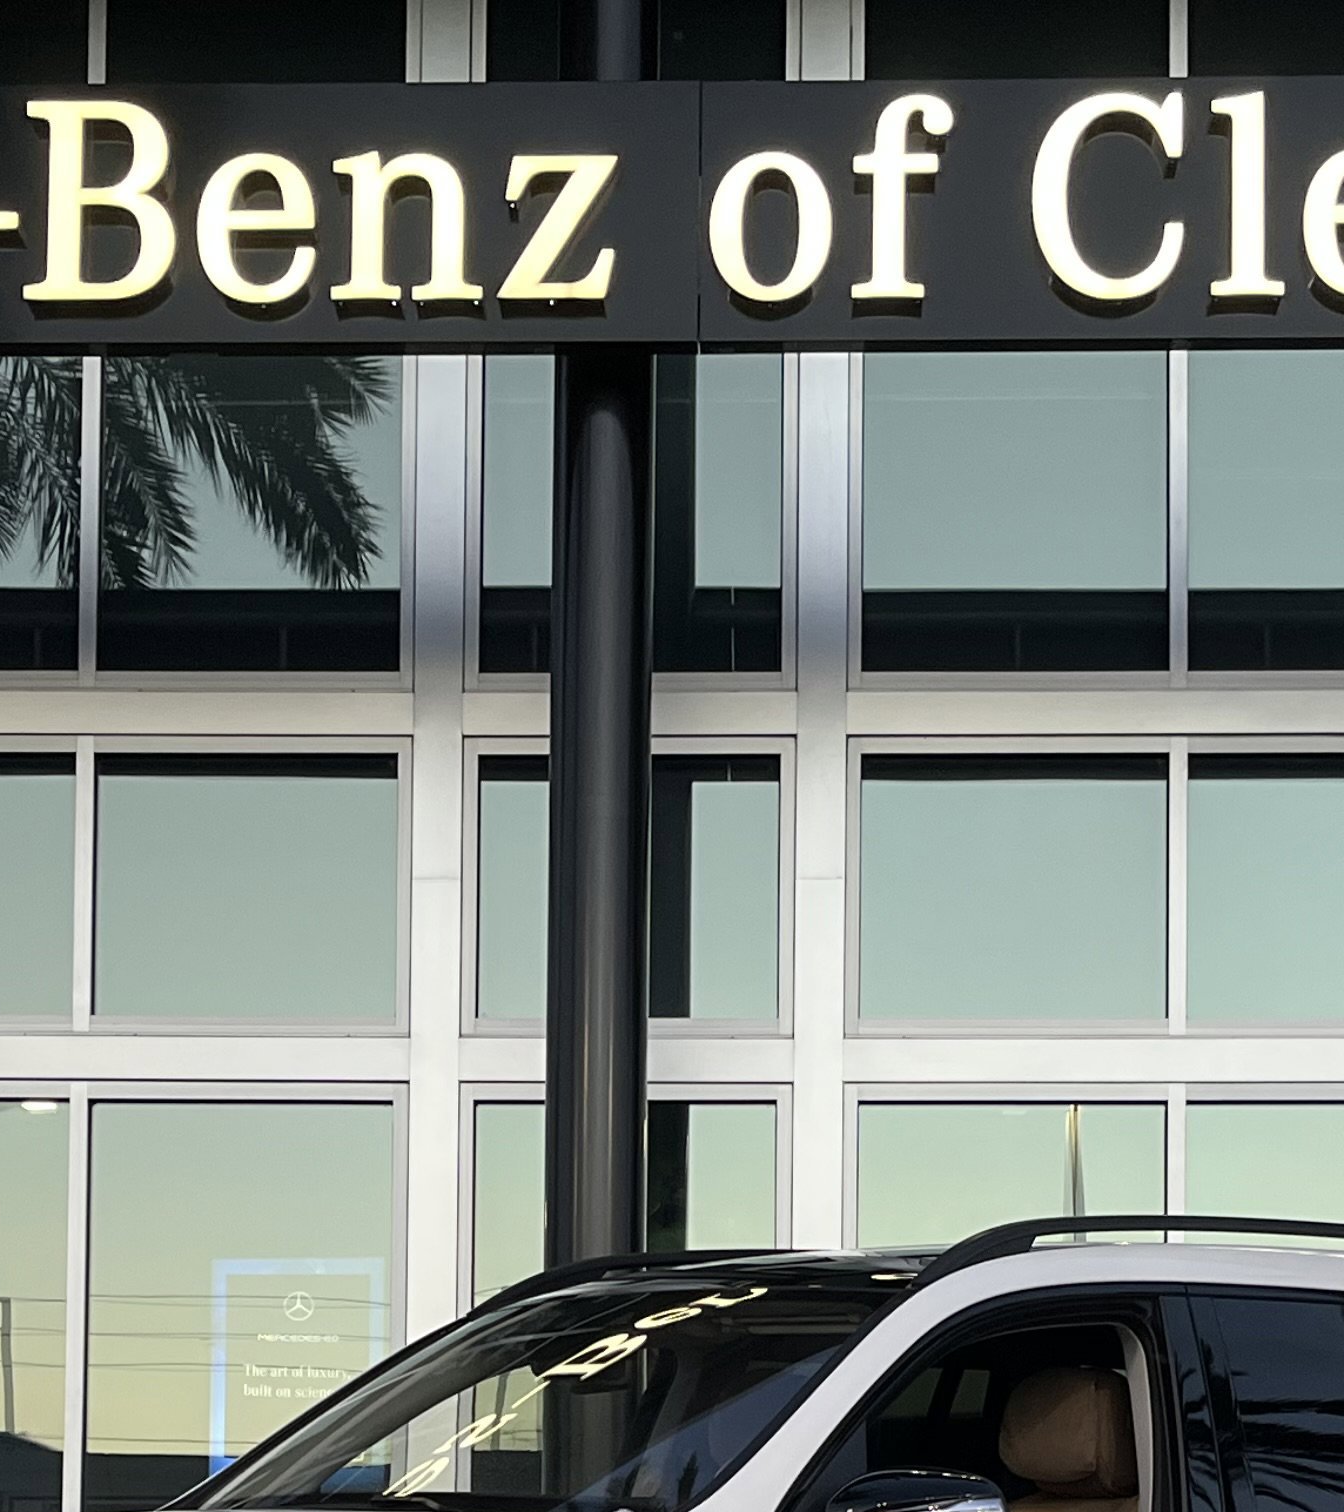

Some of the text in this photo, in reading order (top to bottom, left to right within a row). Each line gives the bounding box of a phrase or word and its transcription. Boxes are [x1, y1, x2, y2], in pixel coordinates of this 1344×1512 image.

[708, 93, 955, 303] of
[243, 1363, 266, 1377] The
[269, 1366, 288, 1378] art
[291, 1364, 305, 1378] of
[243, 1383, 332, 1398] built on scien
